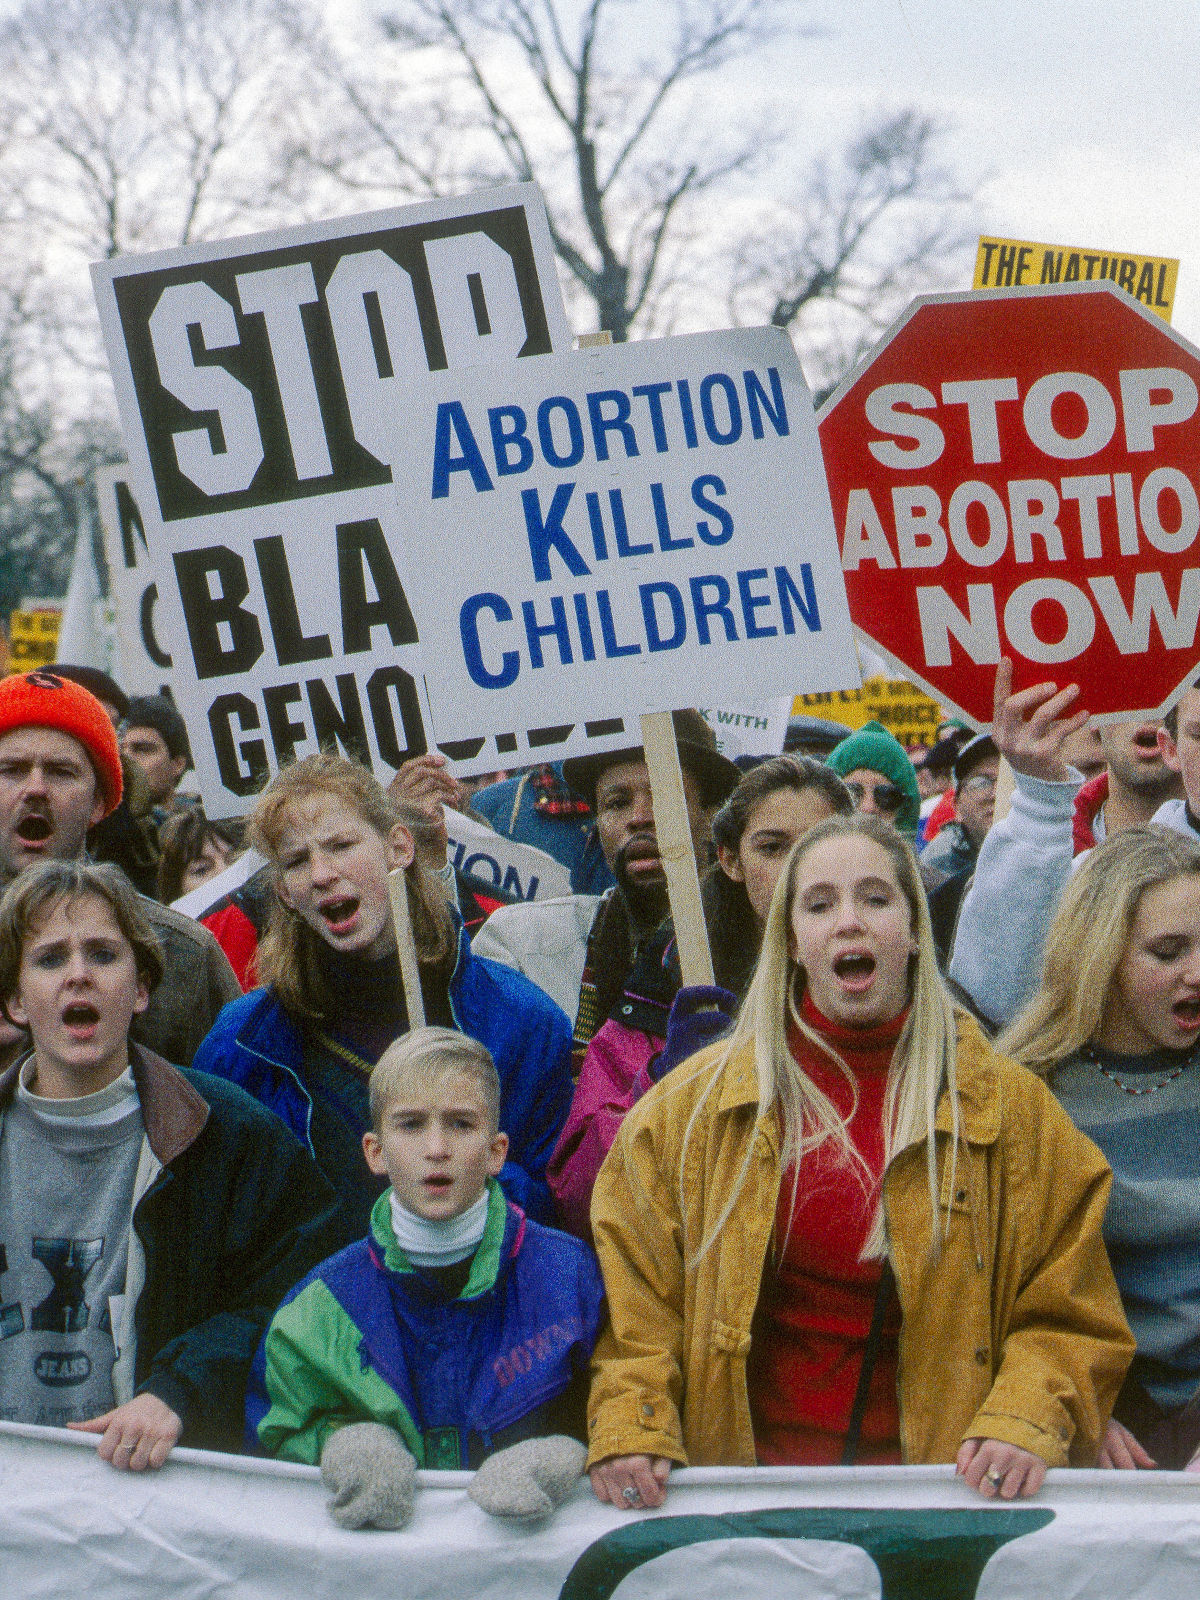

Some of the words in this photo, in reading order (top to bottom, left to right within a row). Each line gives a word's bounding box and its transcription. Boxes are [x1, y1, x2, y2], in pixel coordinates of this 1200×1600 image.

[982, 243, 1033, 287] THE
[148, 231, 528, 497] STOP
[864, 367, 1200, 470] STOP
[431, 367, 791, 500] ABORTION
[520, 474, 735, 583] KILLS
[171, 518, 420, 681] BLA
[459, 563, 823, 690] CHILDREN
[717, 710, 769, 731] WITH
